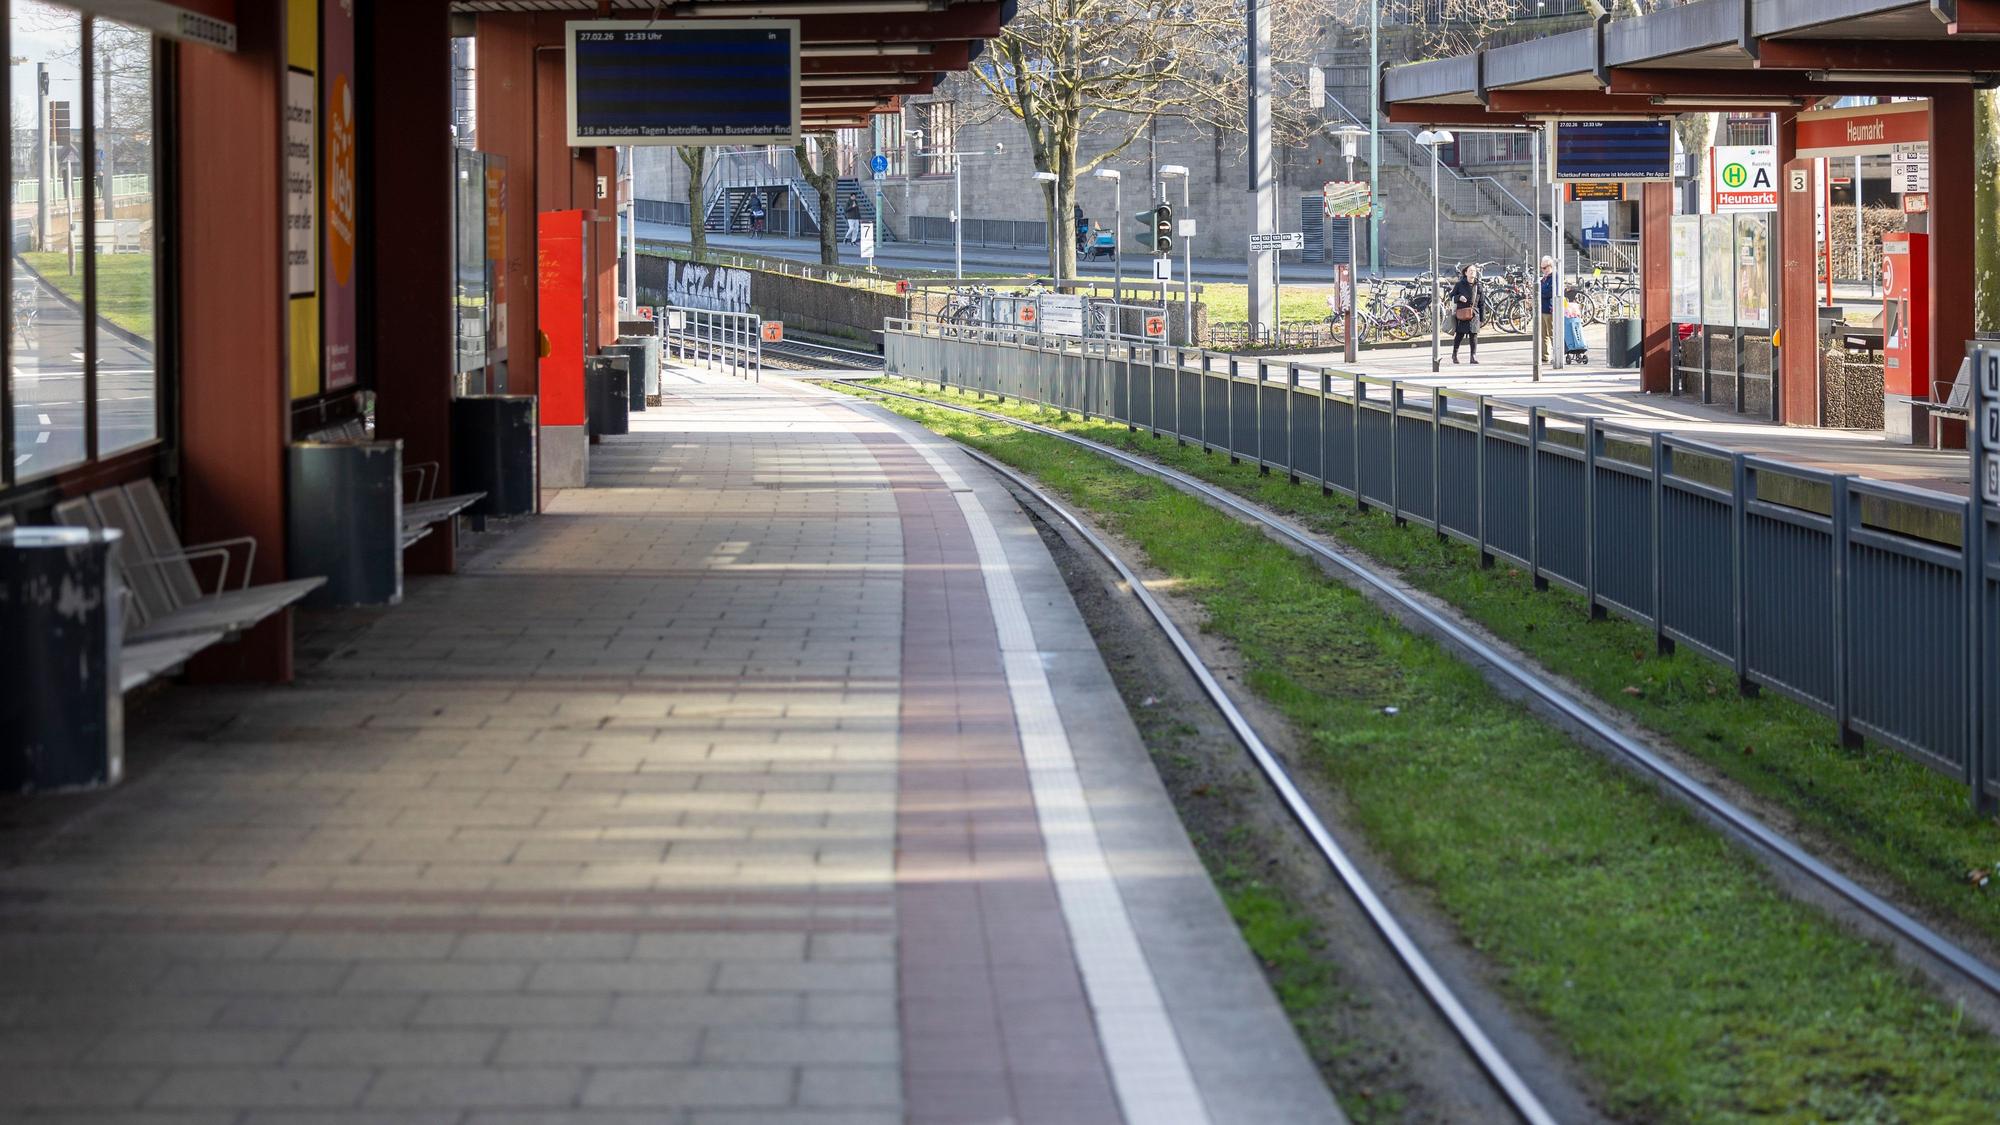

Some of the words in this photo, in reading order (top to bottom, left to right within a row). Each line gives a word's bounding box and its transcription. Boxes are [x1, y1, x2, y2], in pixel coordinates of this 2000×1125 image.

[580, 33, 614, 41] 27.02.26
[624, 33, 646, 41] 12:33
[647, 32, 662, 41] Uhr
[768, 32, 777, 40] in
[584, 127, 594, 135] 18
[609, 126, 638, 135] beiden
[640, 126, 666, 137] Tagen
[668, 126, 710, 135] betroffen.
[712, 126, 724, 135] Im
[726, 125, 773, 134] Busverkehr
[774, 125, 791, 134] find
[1847, 119, 1884, 142] Heumarkt
[1729, 168, 1740, 182] H
[1753, 168, 1771, 188] A
[1794, 177, 1804, 190] 3
[1720, 193, 1774, 204] Heumarkt
[863, 225, 871, 239] 7
[1157, 262, 1168, 280] L
[1990, 411, 1998, 439] 7
[1990, 467, 1998, 492] 9
